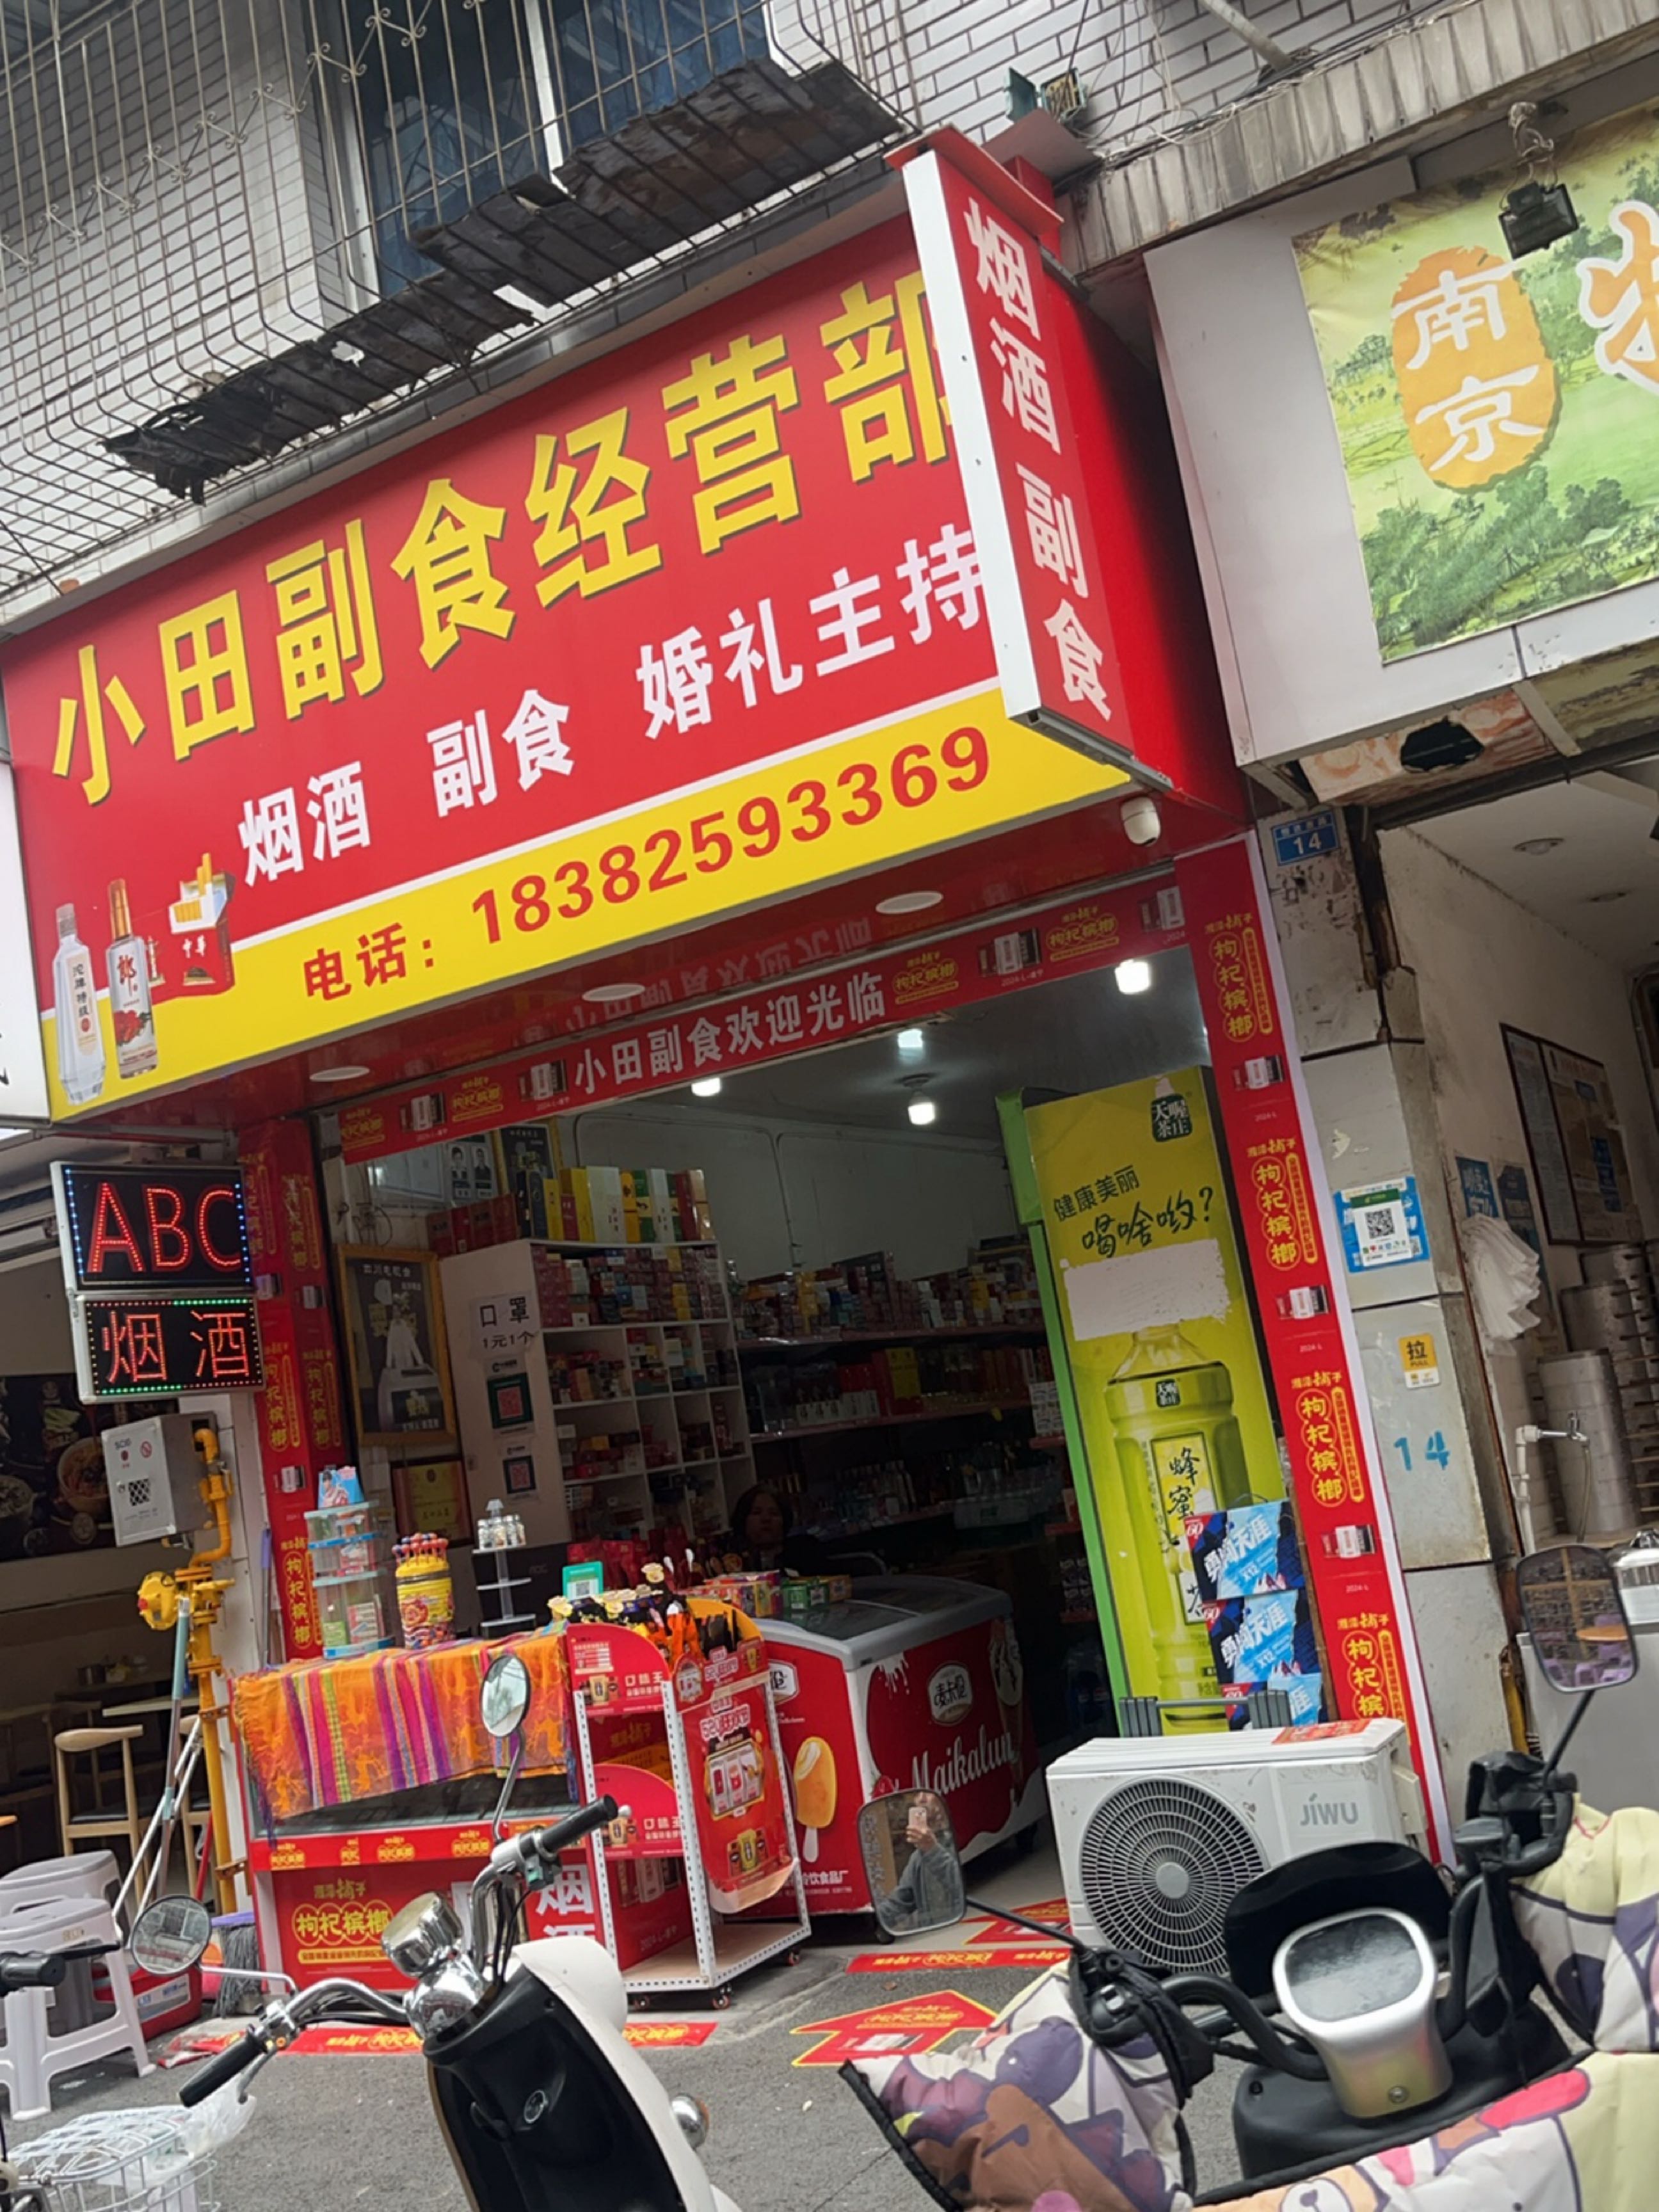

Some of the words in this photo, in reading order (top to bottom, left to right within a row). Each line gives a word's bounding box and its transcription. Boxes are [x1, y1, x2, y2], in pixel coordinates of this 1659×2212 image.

[1391, 259, 1548, 472] 南京
[52, 269, 952, 806] 小田副食经营部
[238, 761, 371, 886] 烟酒
[426, 689, 570, 818] 副食
[636, 522, 984, 739] 婚礼主持
[471, 725, 990, 945] 18382593369
[1294, 833, 1321, 854] 14
[1214, 939, 1254, 1038] 枸杞槟榔
[574, 971, 885, 1095] 小田副食欢迎光临
[87, 1182, 243, 1272] ABC
[1053, 1164, 1140, 1222] 健康美丽
[1256, 1163, 1297, 1265] 枸杞槟榔
[102, 1310, 250, 1383] 烟酒
[479, 1296, 530, 1328] 口罩
[1406, 1340, 1427, 1361] 拉
[1302, 1395, 1343, 1502] 枸杞槟榔
[1393, 1431, 1450, 1471] 14
[1204, 1514, 1272, 1583] 勇闯天涯
[1221, 1601, 1289, 1669] 勇闯天涯
[1349, 1639, 1384, 1717] 枸杞槟
[296, 1908, 393, 1938] 枸杞槟榔
